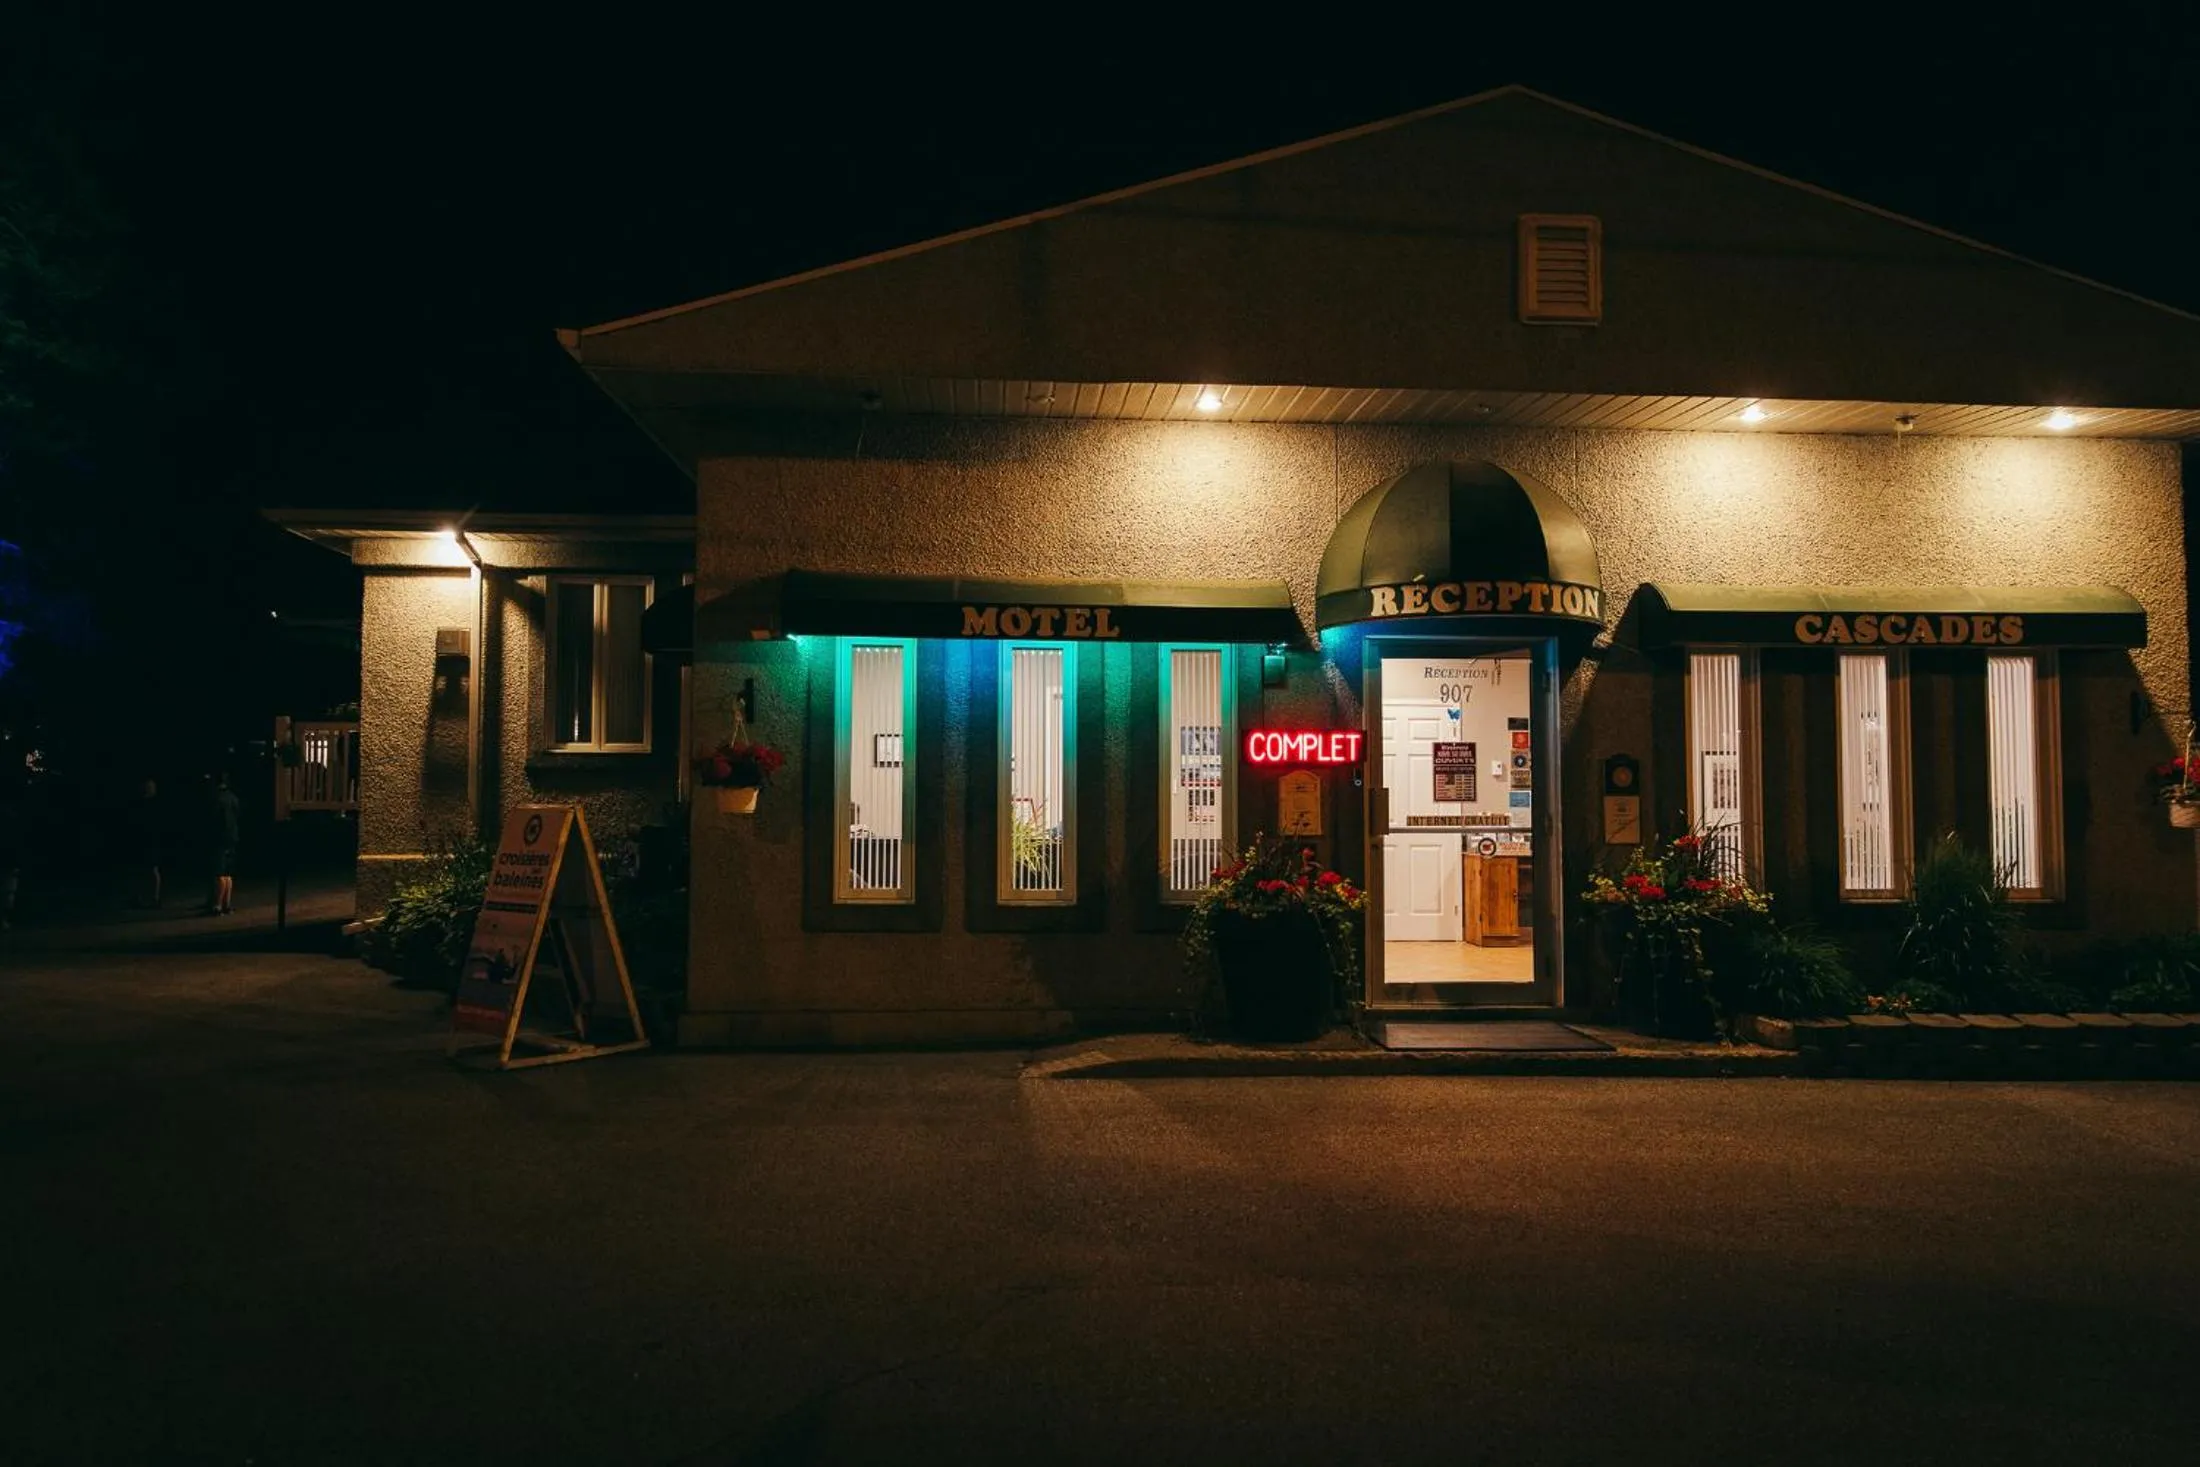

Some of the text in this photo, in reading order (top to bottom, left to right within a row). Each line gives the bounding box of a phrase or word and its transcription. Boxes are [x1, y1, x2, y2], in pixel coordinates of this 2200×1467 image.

[1371, 574, 1599, 617] RÉCEPTION
[961, 606, 1120, 637] MOTEL
[1795, 614, 2024, 644] CASCADES
[1440, 683, 1473, 703] 907
[1249, 732, 1361, 761] COMPLET
[1407, 815, 1460, 826] INTERNET
[494, 870, 543, 888] baleines
